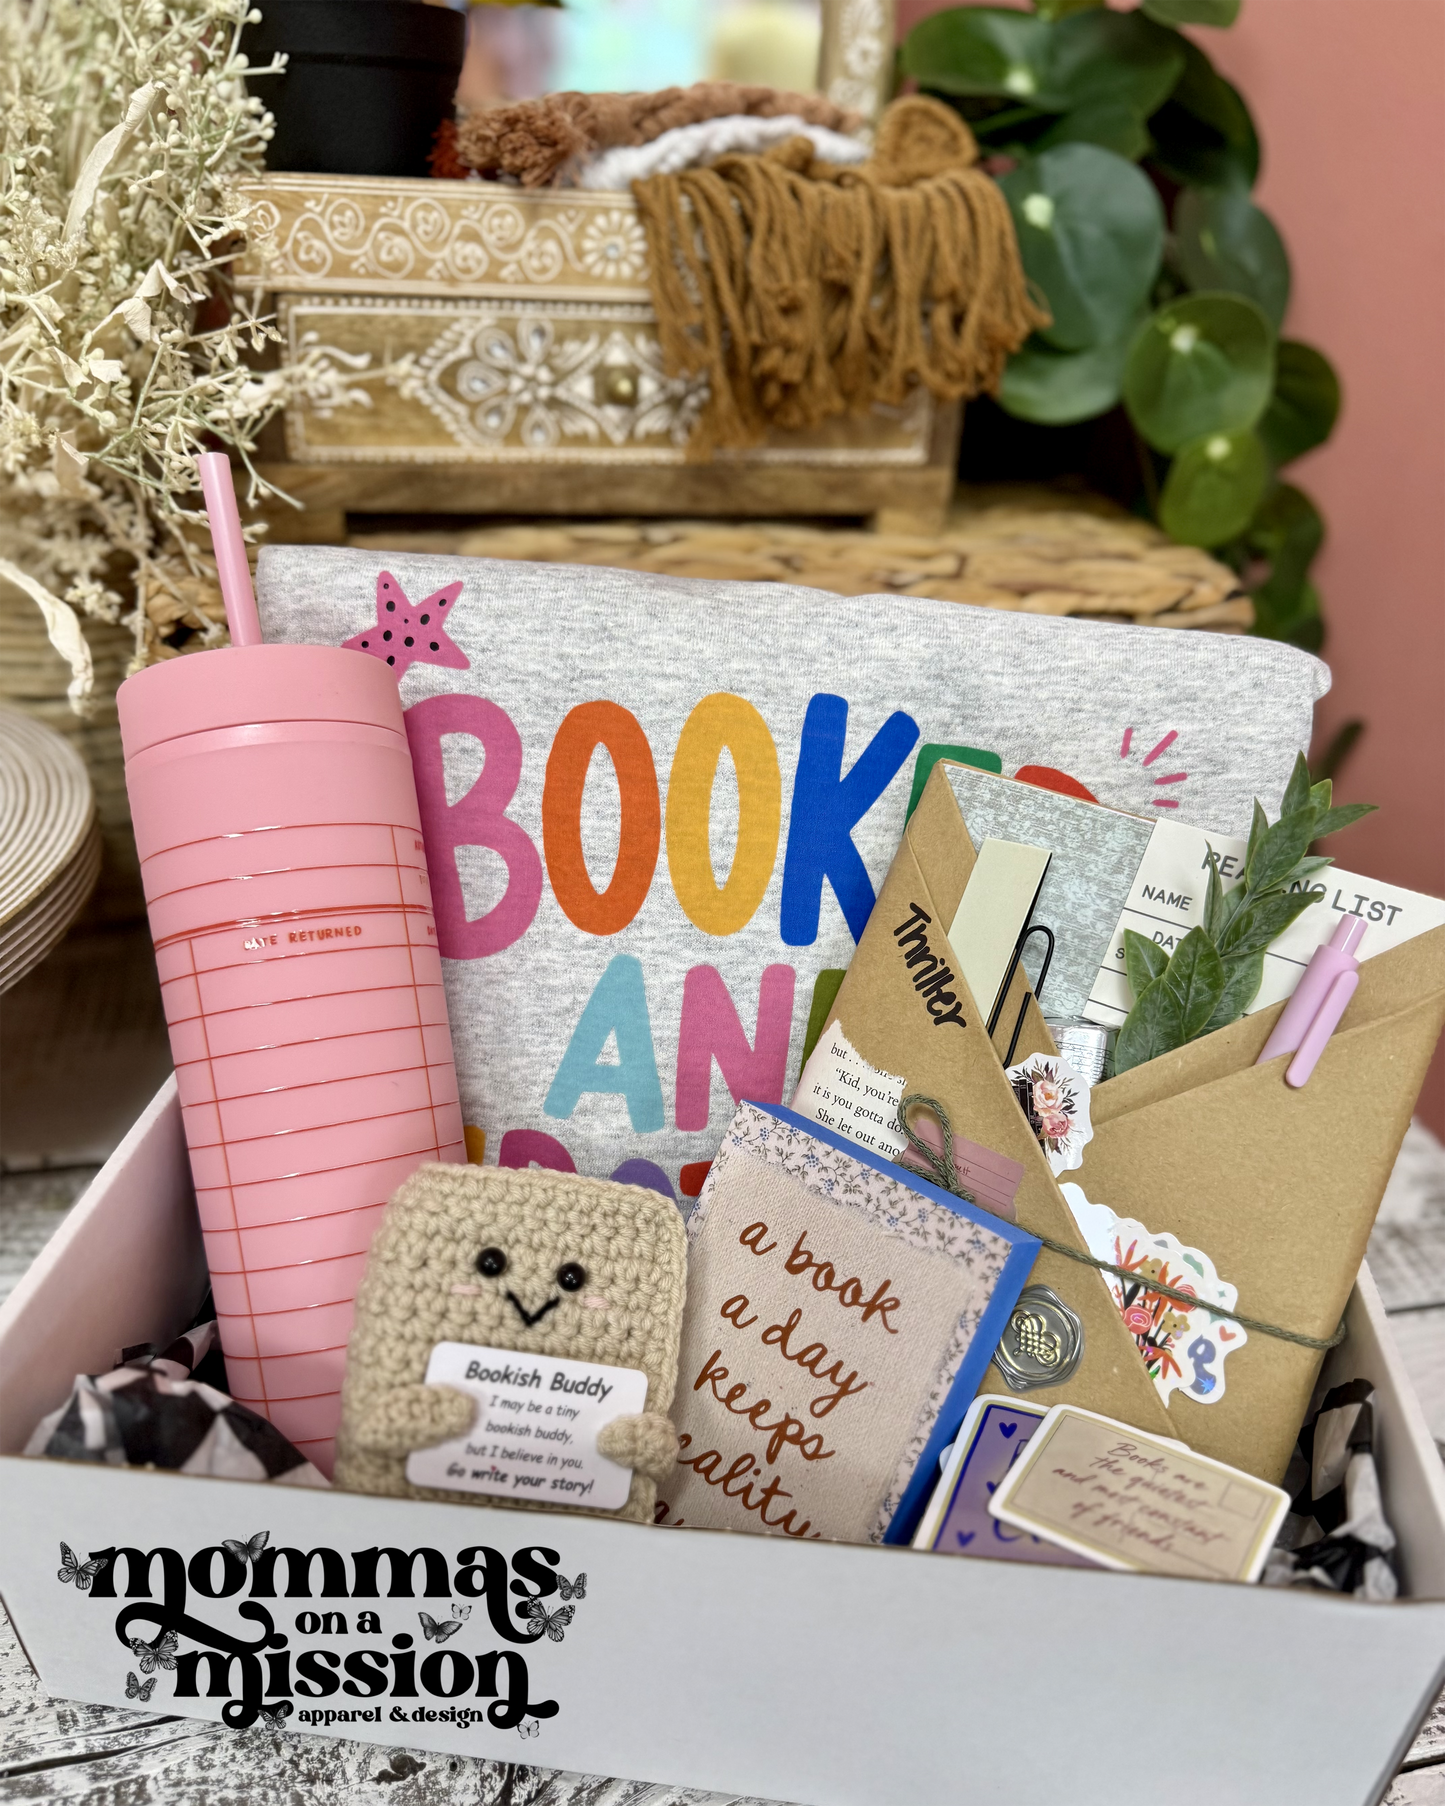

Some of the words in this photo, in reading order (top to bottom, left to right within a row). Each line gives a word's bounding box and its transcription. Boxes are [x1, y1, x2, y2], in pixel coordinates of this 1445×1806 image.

[404, 691, 1099, 960] BOOK
[1141, 884, 1193, 911] NAME
[1331, 888, 1403, 926] LIST
[289, 926, 362, 943] RETURNED
[893, 902, 967, 1028] Thriller
[830, 1042, 848, 1060] but
[812, 1082, 821, 1095] it
[822, 1087, 831, 1100] is
[832, 1094, 853, 1110] you
[854, 1105, 884, 1125] gotta
[886, 1118, 904, 1135] do.
[815, 1107, 835, 1126] She
[838, 1117, 852, 1135] let
[855, 1130, 876, 1146] out
[739, 1221, 778, 1256] a
[784, 1230, 901, 1334] book
[720, 1294, 759, 1329] a
[761, 1308, 869, 1419] day
[465, 1361, 541, 1389] Bookish
[550, 1372, 613, 1403] Buddy
[489, 1395, 499, 1407] I
[500, 1400, 525, 1414] may
[526, 1400, 543, 1414] be
[545, 1407, 553, 1415] a
[556, 1405, 580, 1421] tiny
[694, 1349, 836, 1465] keeps
[485, 1419, 531, 1438] bookish
[534, 1425, 574, 1445] buddy,
[465, 1444, 487, 1457] but
[489, 1445, 500, 1458] I
[501, 1446, 543, 1464] believe
[546, 1452, 561, 1465] in
[560, 1457, 584, 1470] you.
[1089, 1456, 1126, 1476] the
[1107, 1443, 1169, 1473] Books
[446, 1463, 466, 1478] Go
[471, 1465, 508, 1483] write
[512, 1475, 546, 1489] your
[550, 1476, 595, 1496] story!
[677, 1433, 822, 1538] eality
[1052, 1468, 1098, 1484] and
